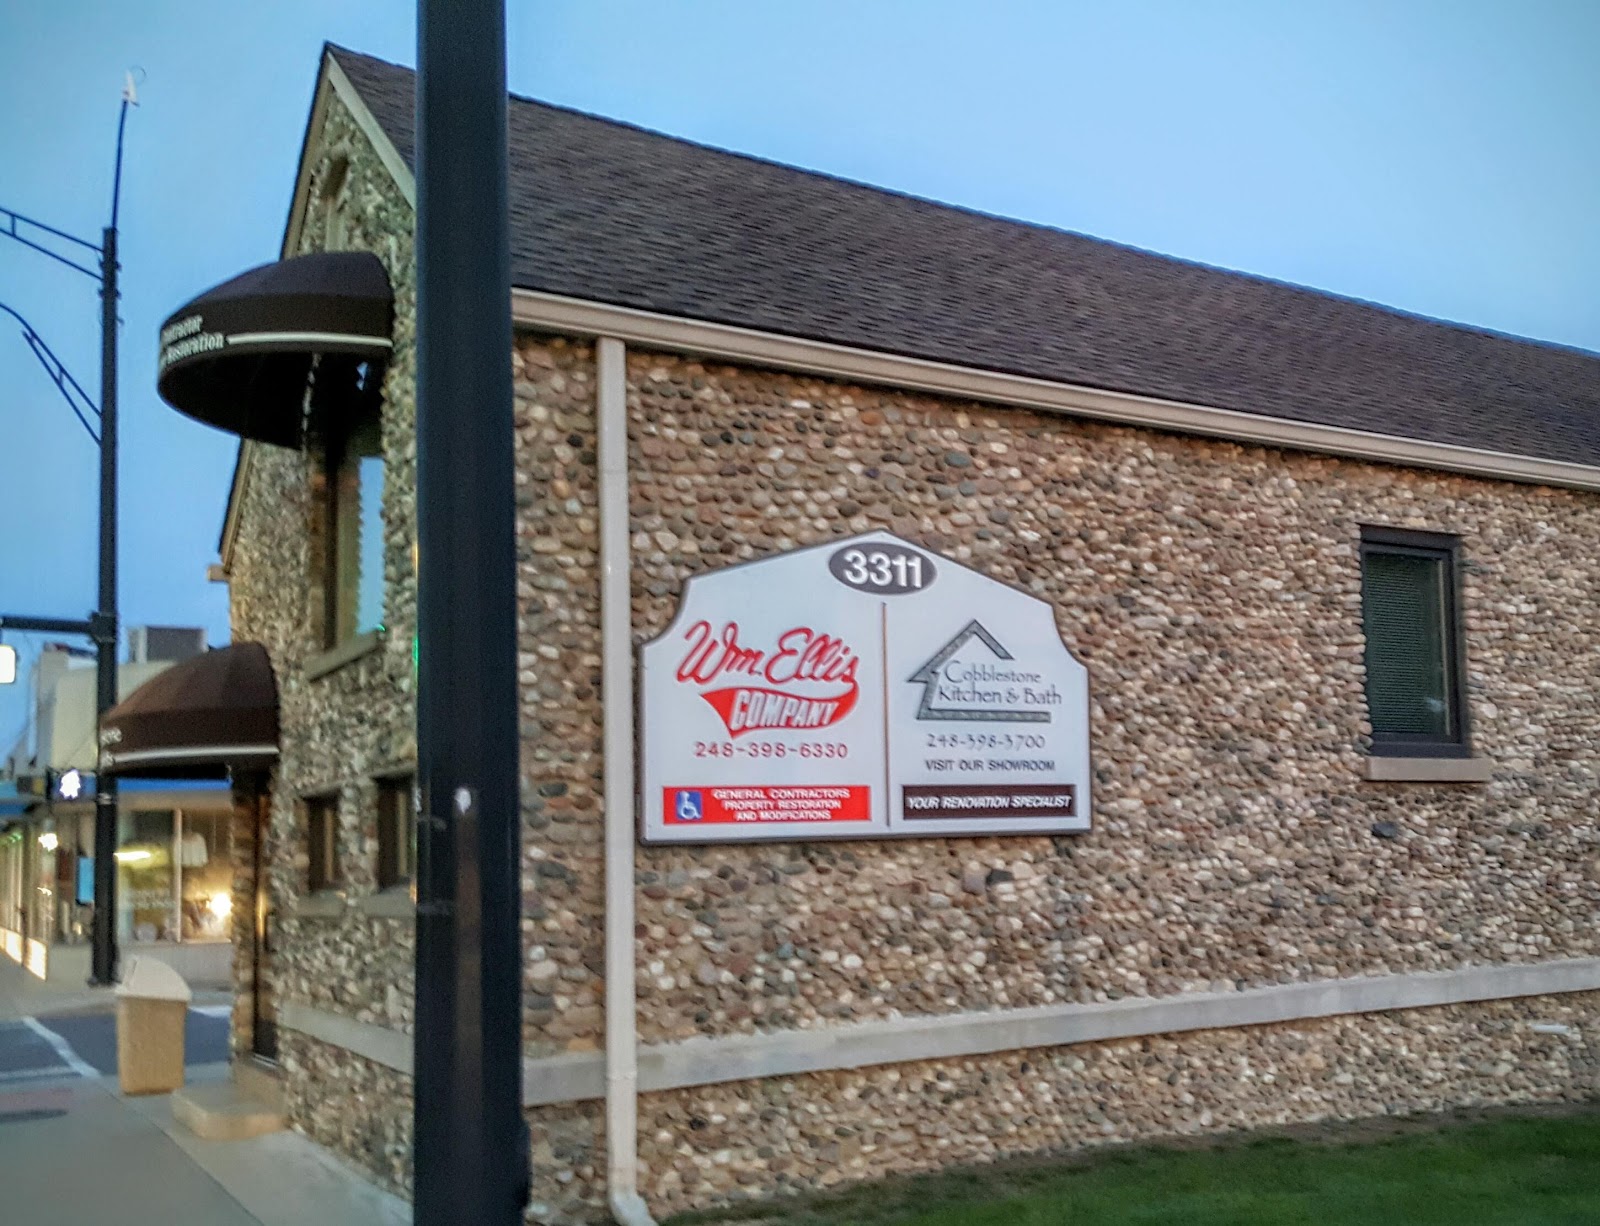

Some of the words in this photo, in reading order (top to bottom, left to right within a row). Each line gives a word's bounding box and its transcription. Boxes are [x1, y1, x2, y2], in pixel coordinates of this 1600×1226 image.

[843, 549, 922, 588] 3311
[765, 626, 859, 684] Ellis
[945, 660, 1041, 684] Cobblestone
[938, 682, 1002, 703] Kitchen
[1006, 688, 1020, 704] &
[1024, 684, 1063, 705] Bath
[729, 689, 840, 731] COMPANY
[694, 741, 848, 759] 248-398-6330
[926, 733, 1046, 751] 248-398-3700
[924, 759, 955, 771] VISIT
[959, 760, 984, 771] OUR
[988, 759, 1056, 771] SHOWROOM
[712, 788, 767, 800] GENERAL
[769, 787, 850, 799] CONTRACTORS
[907, 796, 940, 809] YOUR
[941, 795, 1010, 809] RENOVATION
[1011, 795, 1072, 807] SPECIALIST
[723, 800, 774, 811] PROPERTY
[778, 799, 842, 810] RESTORATION
[735, 811, 757, 821] AND
[760, 810, 831, 821] MODIFICATIONS
